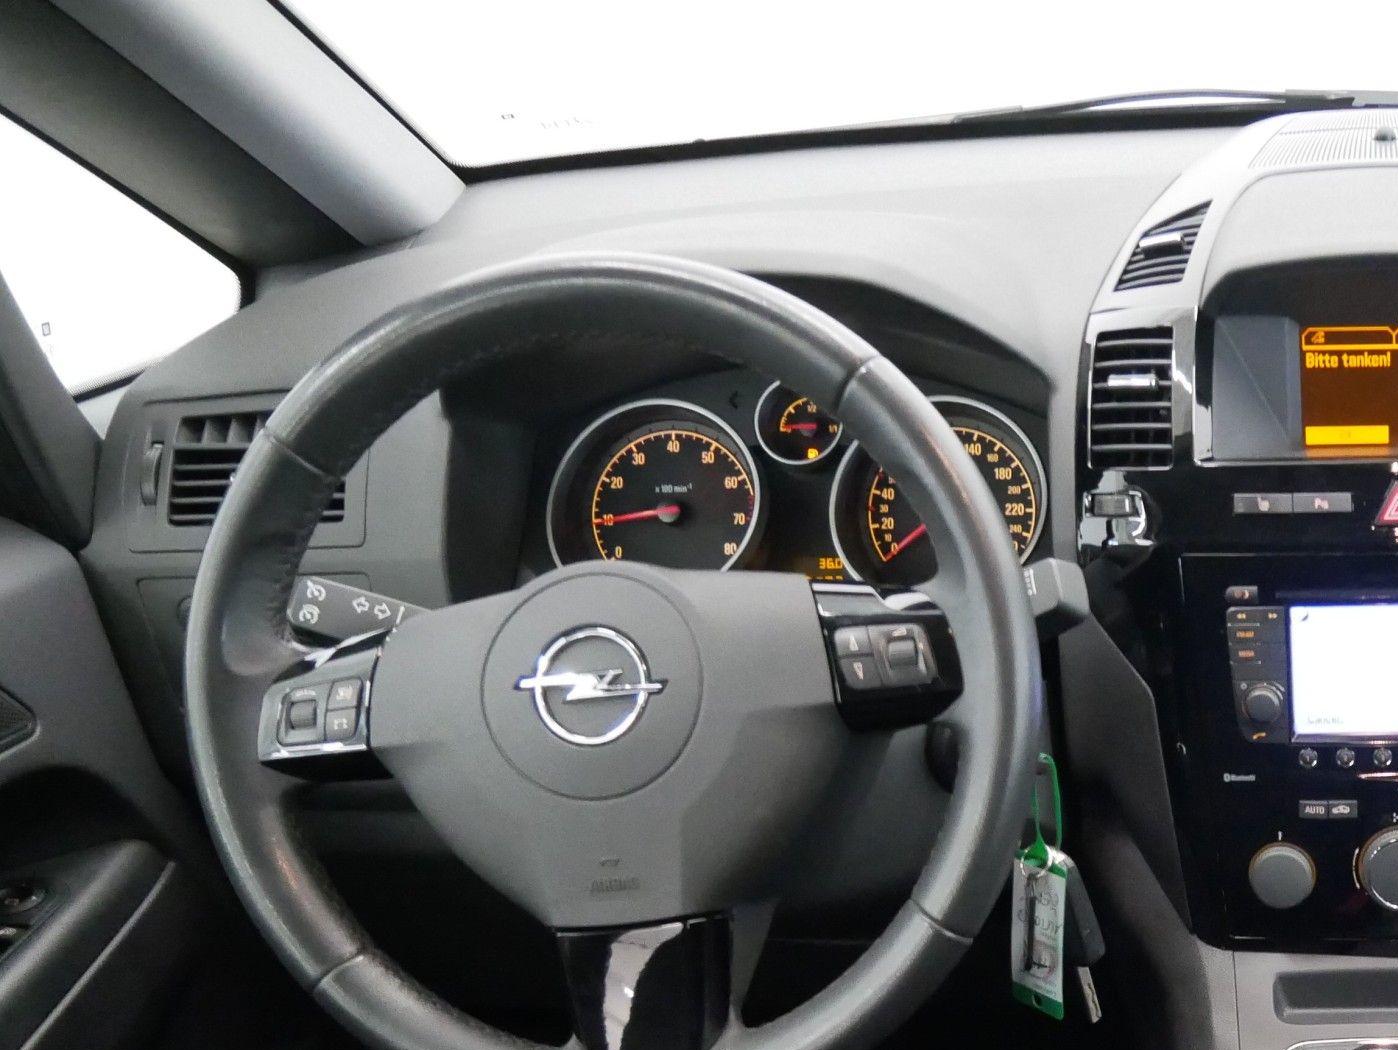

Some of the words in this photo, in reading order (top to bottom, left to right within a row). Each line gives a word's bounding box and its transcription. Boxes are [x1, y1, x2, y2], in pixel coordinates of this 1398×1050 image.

[1305, 352, 1339, 368] Bitte
[1342, 351, 1391, 368] tanken!
[667, 440, 680, 453] 40
[632, 453, 645, 465] 30
[701, 452, 714, 464] 50
[994, 467, 1012, 480] 180
[610, 477, 623, 489] 20
[724, 477, 738, 489] 60
[881, 488, 895, 500] 40
[1008, 485, 1021, 495] 200
[879, 504, 888, 513] 30
[1005, 503, 1025, 516] 220
[603, 514, 614, 526] 10
[733, 513, 745, 525] 70
[881, 518, 894, 529] 20
[615, 546, 622, 558] 0
[724, 543, 737, 555] 80
[1305, 805, 1325, 814] AUTO
